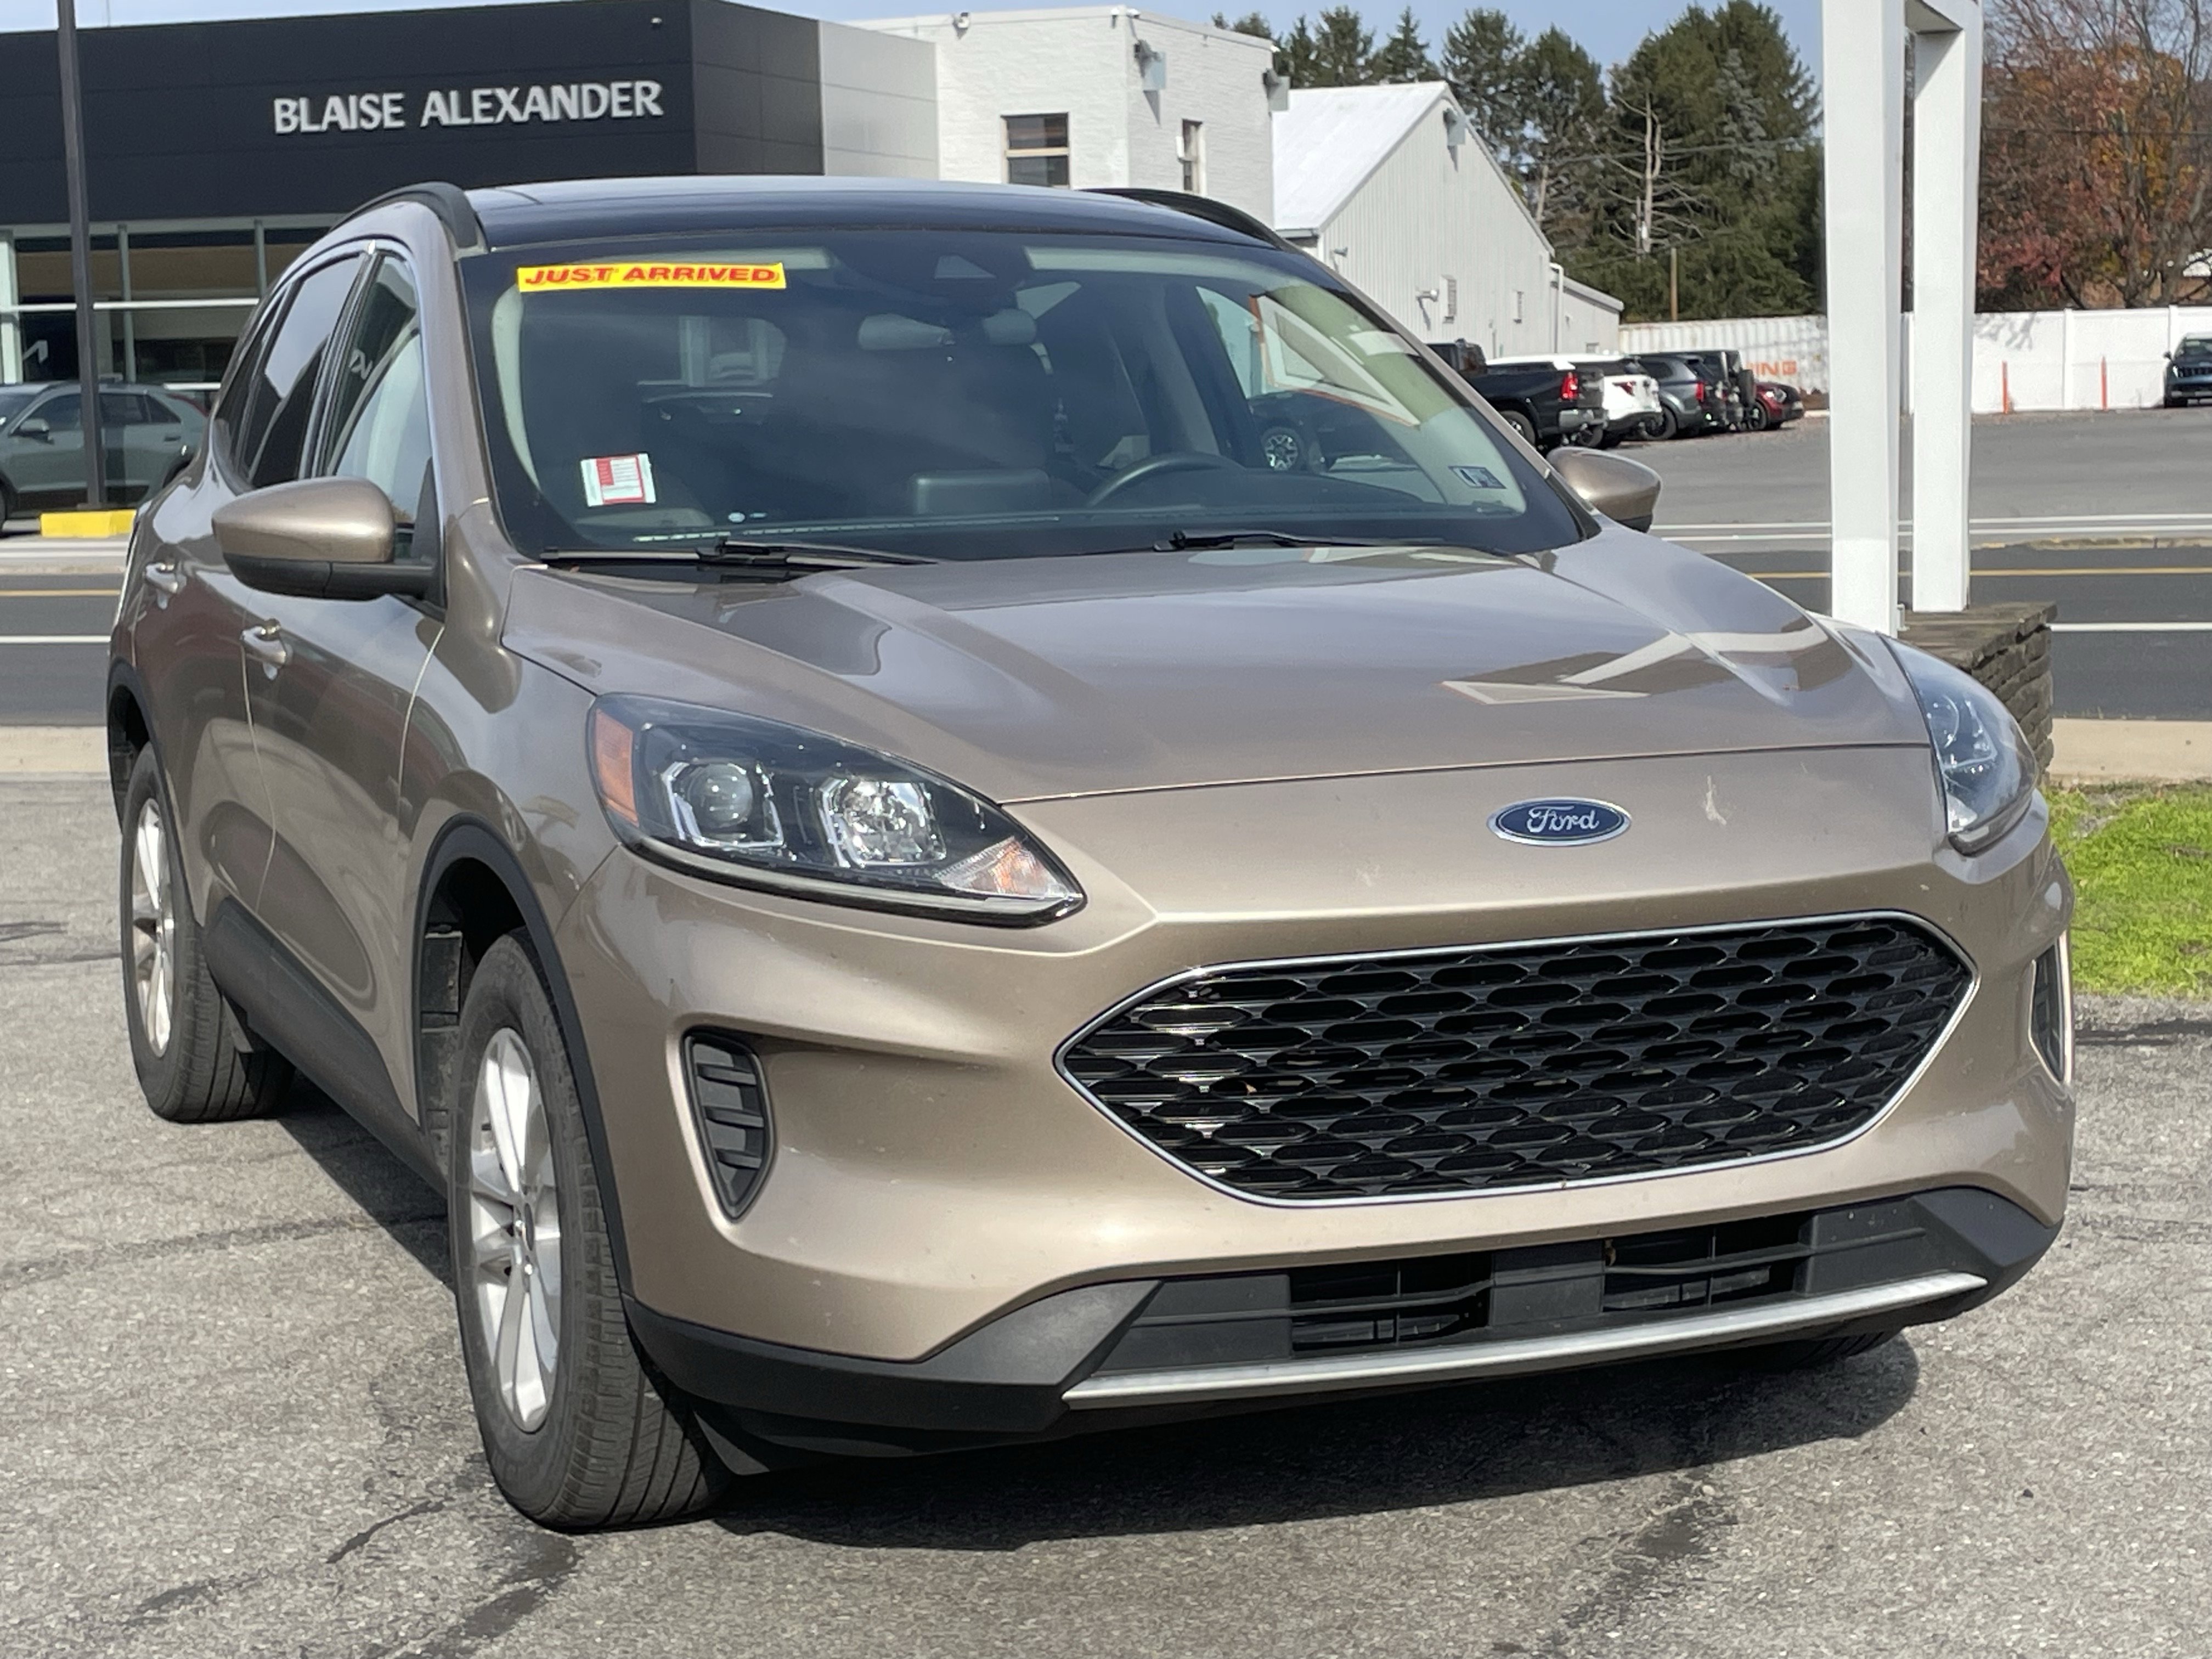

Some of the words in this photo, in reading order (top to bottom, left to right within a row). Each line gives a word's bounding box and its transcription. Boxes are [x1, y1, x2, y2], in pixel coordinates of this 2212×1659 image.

[274, 93, 405, 134] BLAISE
[419, 80, 663, 127] ALEXANDER
[525, 267, 616, 285] JUST
[623, 267, 779, 283] ARRIVED
[1526, 805, 1600, 833] Ford
